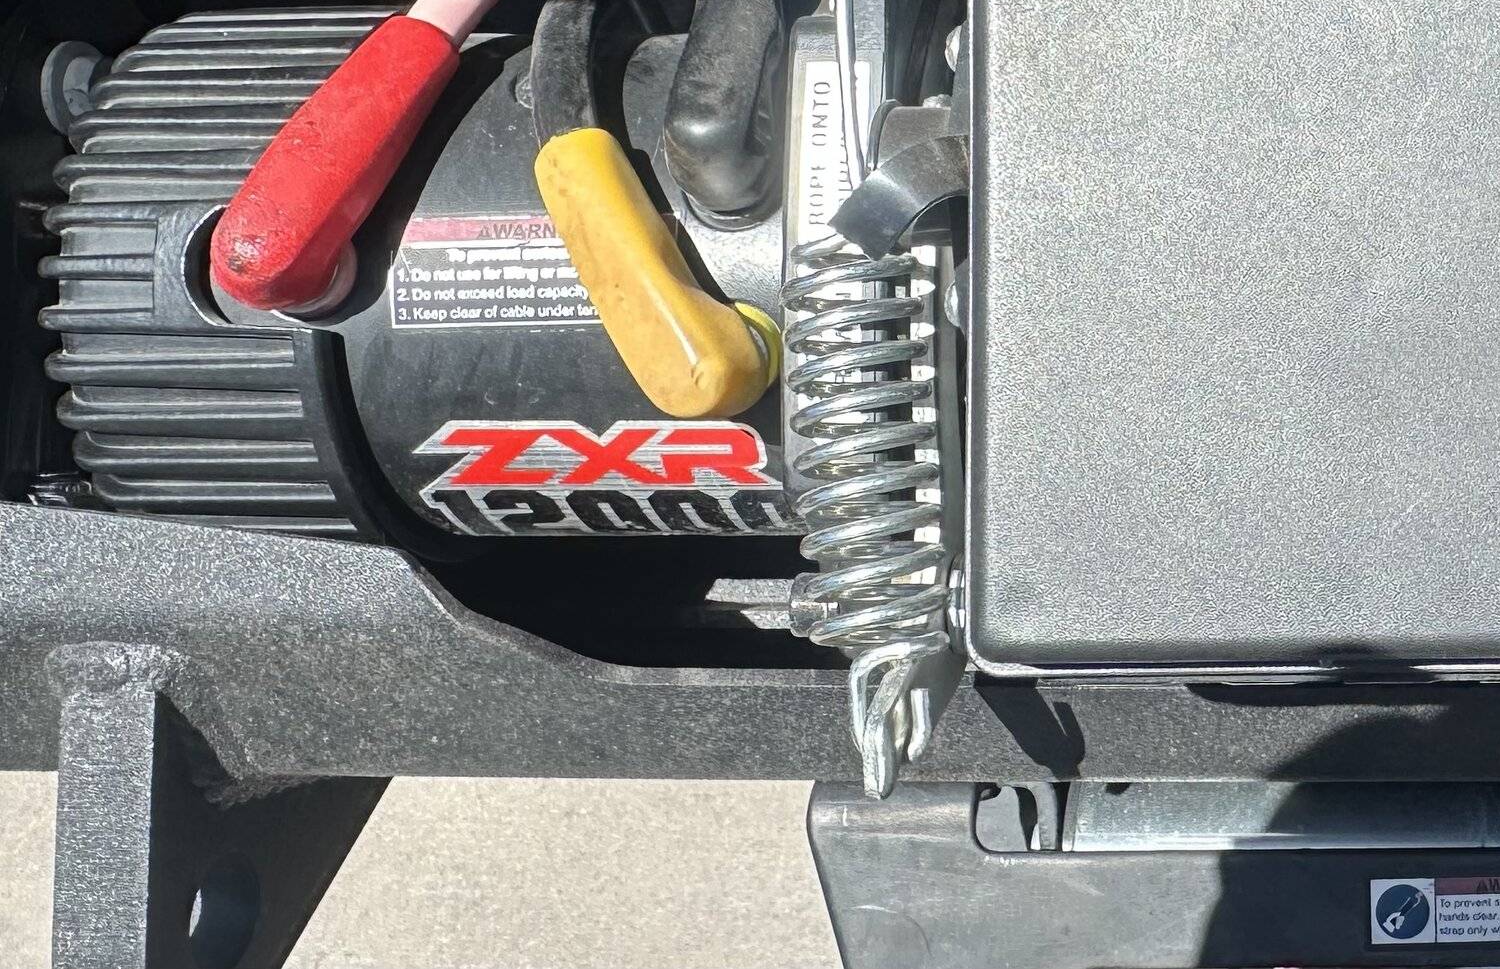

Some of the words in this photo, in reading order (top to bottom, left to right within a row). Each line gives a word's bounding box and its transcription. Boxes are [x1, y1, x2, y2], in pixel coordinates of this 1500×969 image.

[811, 81, 831, 147] ONTO
[397, 267, 409, 282] 1.
[411, 267, 431, 282] Do
[433, 268, 455, 281] not
[397, 288, 410, 301] 2.
[411, 288, 431, 301] Do
[434, 288, 455, 301] not
[457, 286, 504, 300] exceed
[506, 285, 535, 299] load
[537, 284, 588, 300] capacity
[398, 307, 411, 320] 3.
[413, 307, 447, 321] Keep
[450, 306, 481, 319] clear
[484, 304, 497, 318] of
[500, 304, 535, 317] cable
[537, 303, 575, 317] under
[422, 423, 776, 488] ZXR
[1440, 898, 1451, 908] To
[1454, 898, 1491, 909] prevent
[1439, 912, 1470, 921] hands
[1440, 927, 1465, 935] strap
[1467, 925, 1488, 936] only
